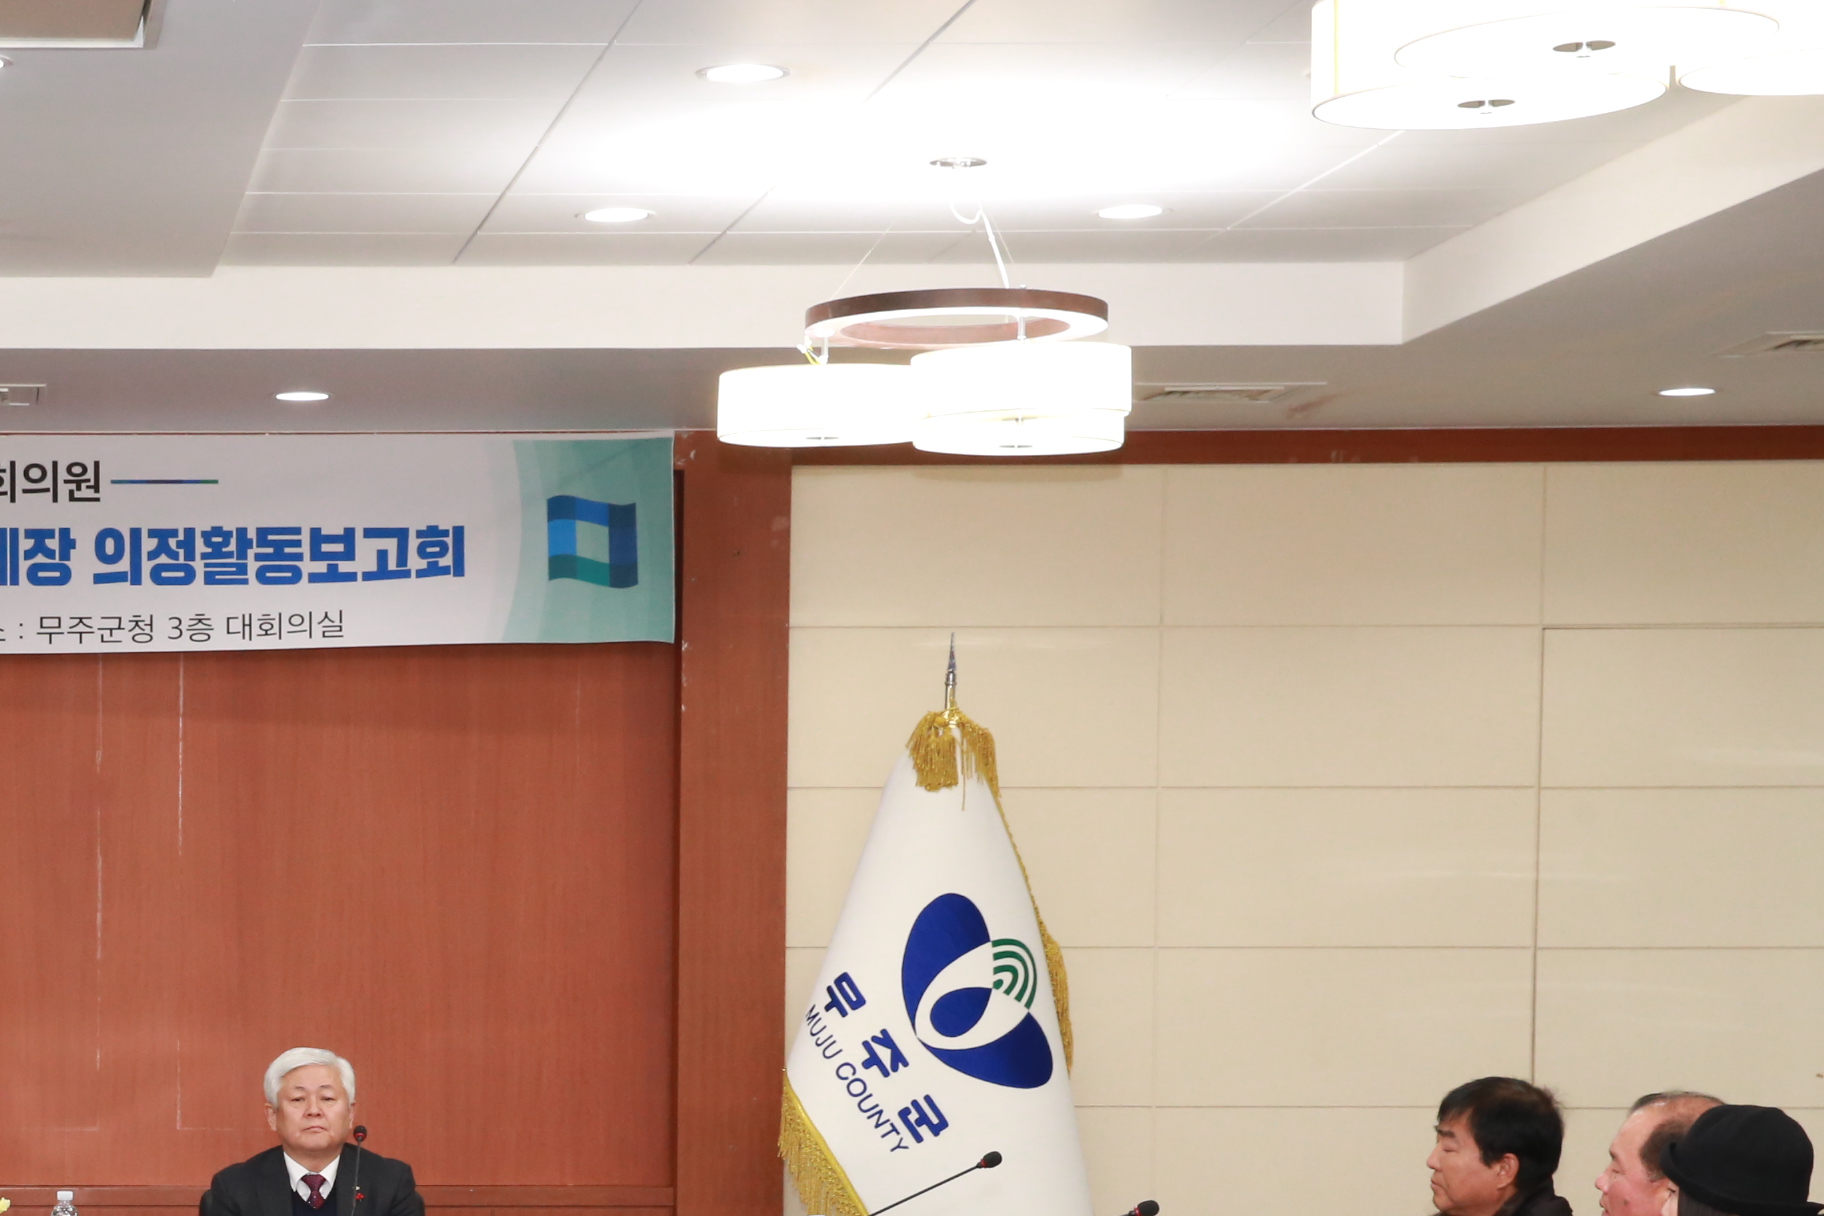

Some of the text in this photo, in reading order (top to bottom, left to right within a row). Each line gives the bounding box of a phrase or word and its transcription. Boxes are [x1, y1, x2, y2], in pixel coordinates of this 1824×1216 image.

[92, 524, 465, 586] 의정활동보고회
[36, 614, 155, 645] 무주군청
[166, 614, 214, 645] 3층
[225, 610, 345, 642] 대회의실
[805, 1003, 910, 1153] MUJU COUNTY
[824, 971, 950, 1144] 무주군
